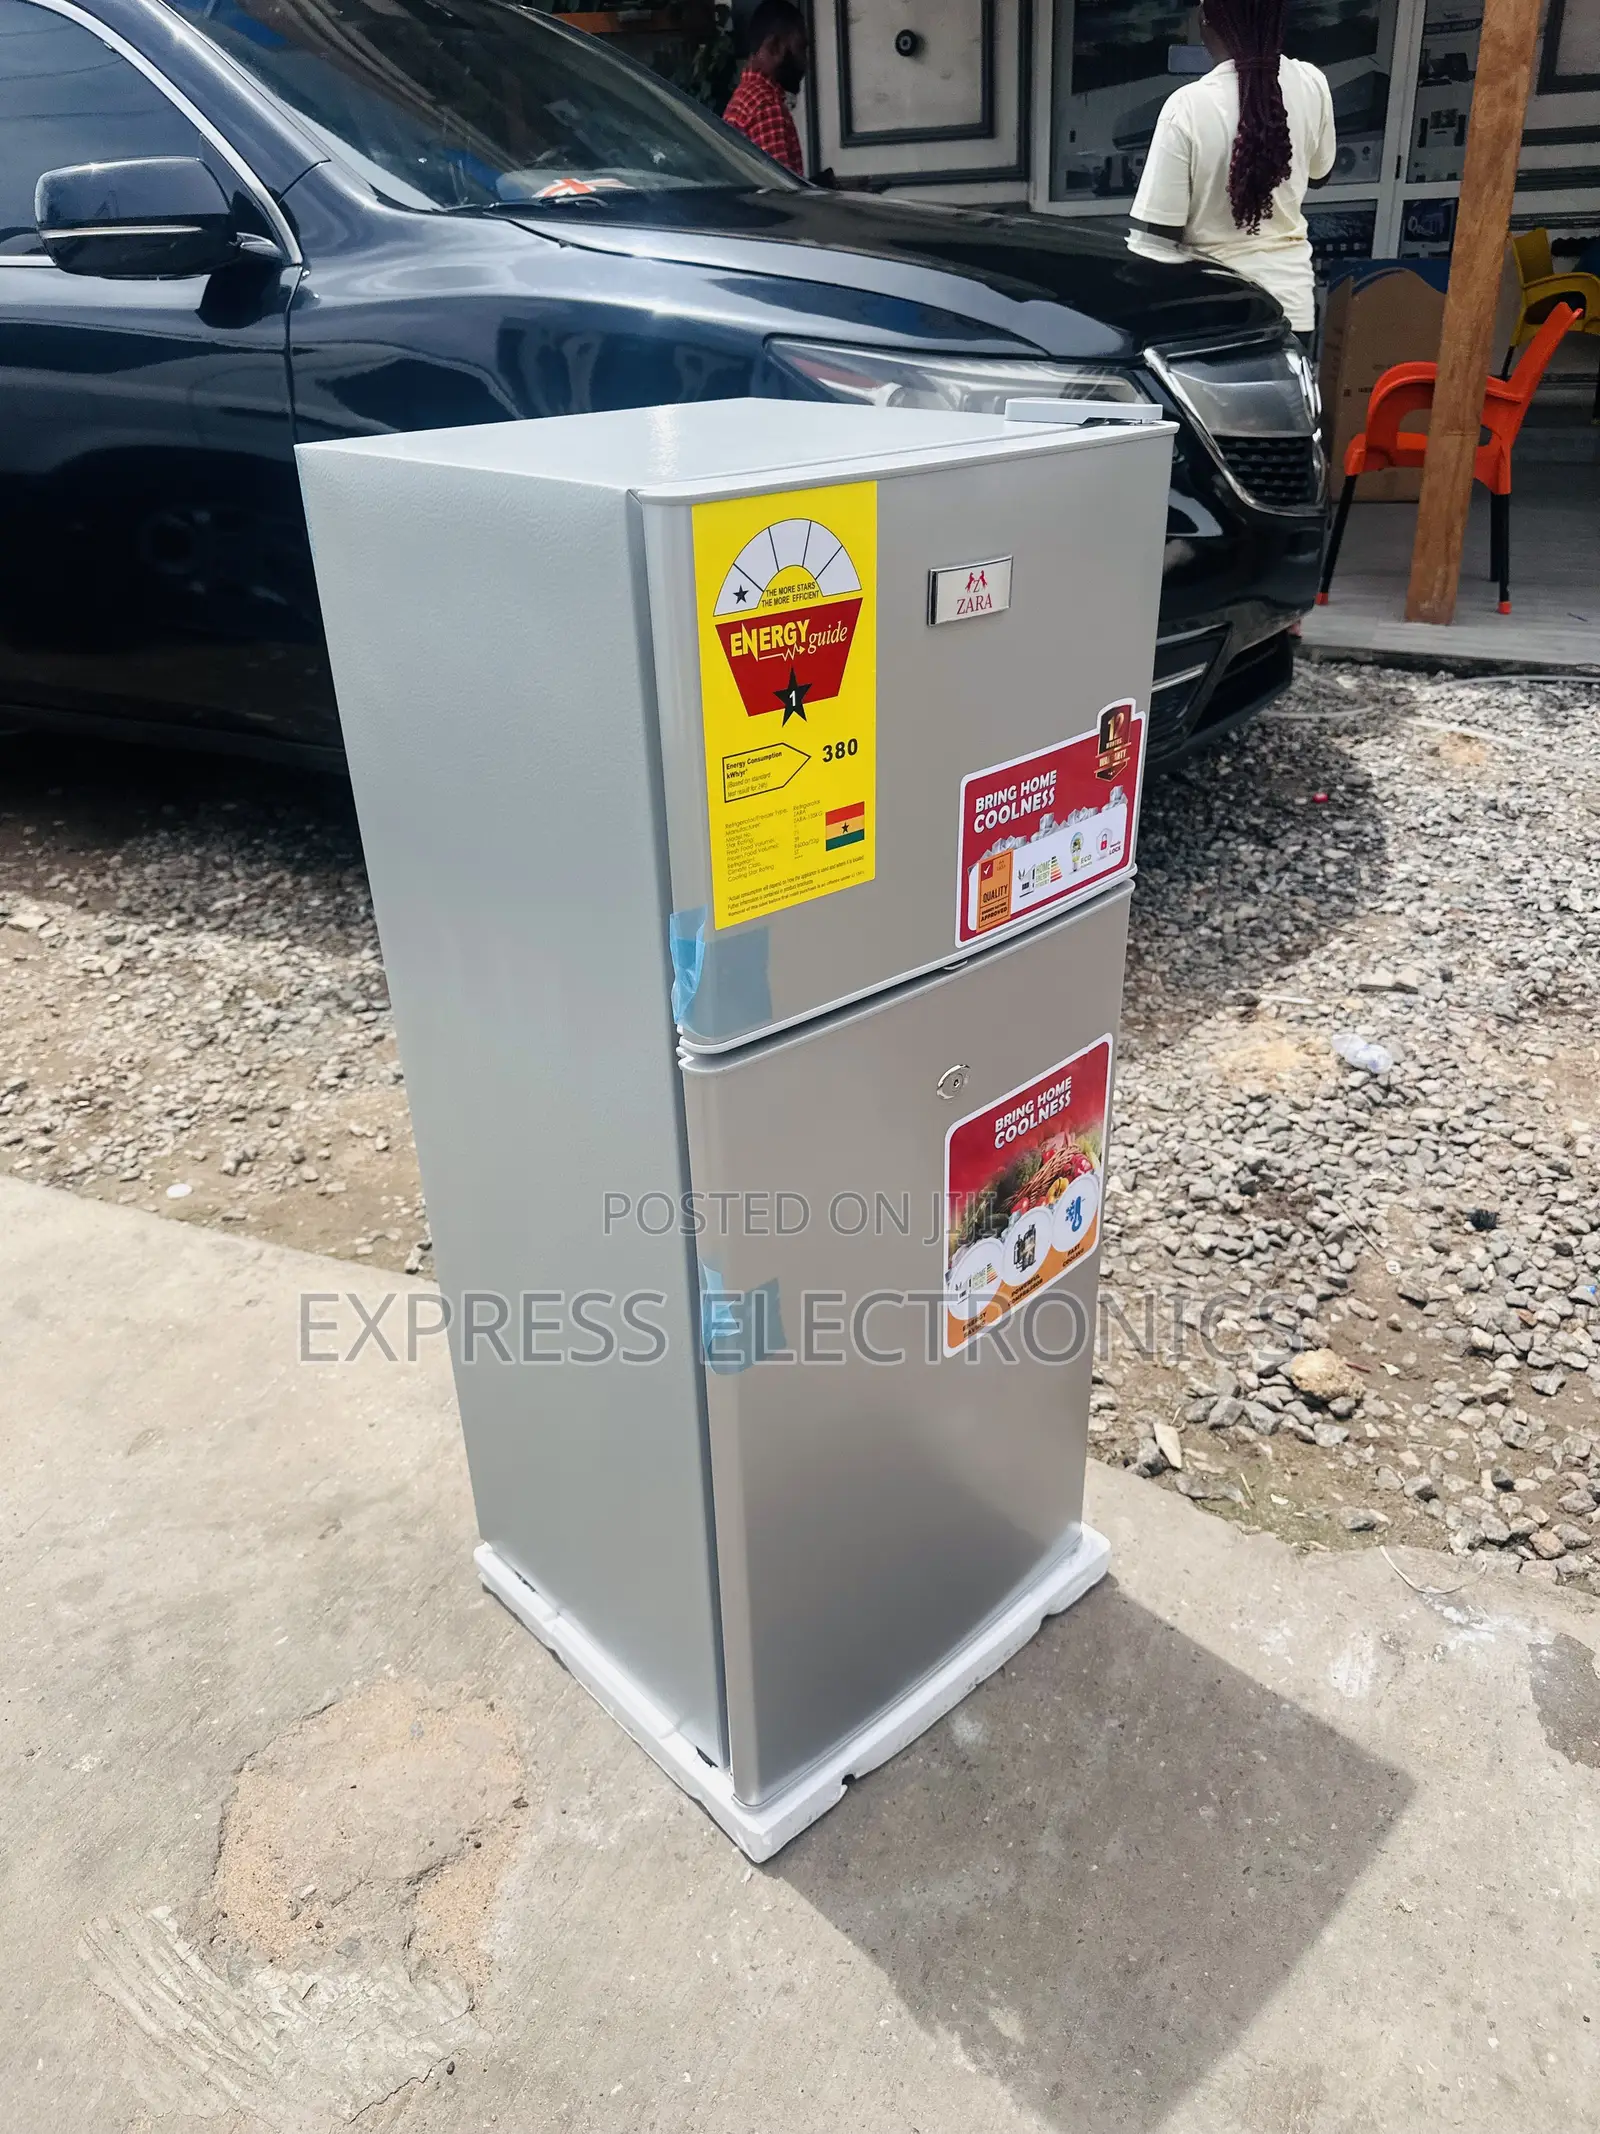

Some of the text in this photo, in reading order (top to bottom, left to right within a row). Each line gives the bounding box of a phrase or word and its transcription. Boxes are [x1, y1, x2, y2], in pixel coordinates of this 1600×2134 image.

[761, 590, 820, 608] THE MORE EFFICIENT
[766, 582, 816, 597] THE MORE STARS
[956, 593, 993, 615] ZARA
[730, 618, 848, 662] ENERGY guide
[789, 690, 796, 707] 1
[1107, 712, 1125, 742] 12
[726, 752, 783, 770] Energy Consumption
[822, 738, 858, 763] 380
[975, 769, 1058, 814] BRING HOME
[973, 786, 1056, 834] COOLNESS
[982, 883, 1009, 904] QUALITY
[981, 906, 1008, 922] APPROVED
[994, 1075, 1072, 1133] BRING HOME
[994, 1090, 1072, 1150] COOLNESS
[1067, 1243, 1081, 1257] FAST
[1011, 1273, 1041, 1298] POWERFUL
